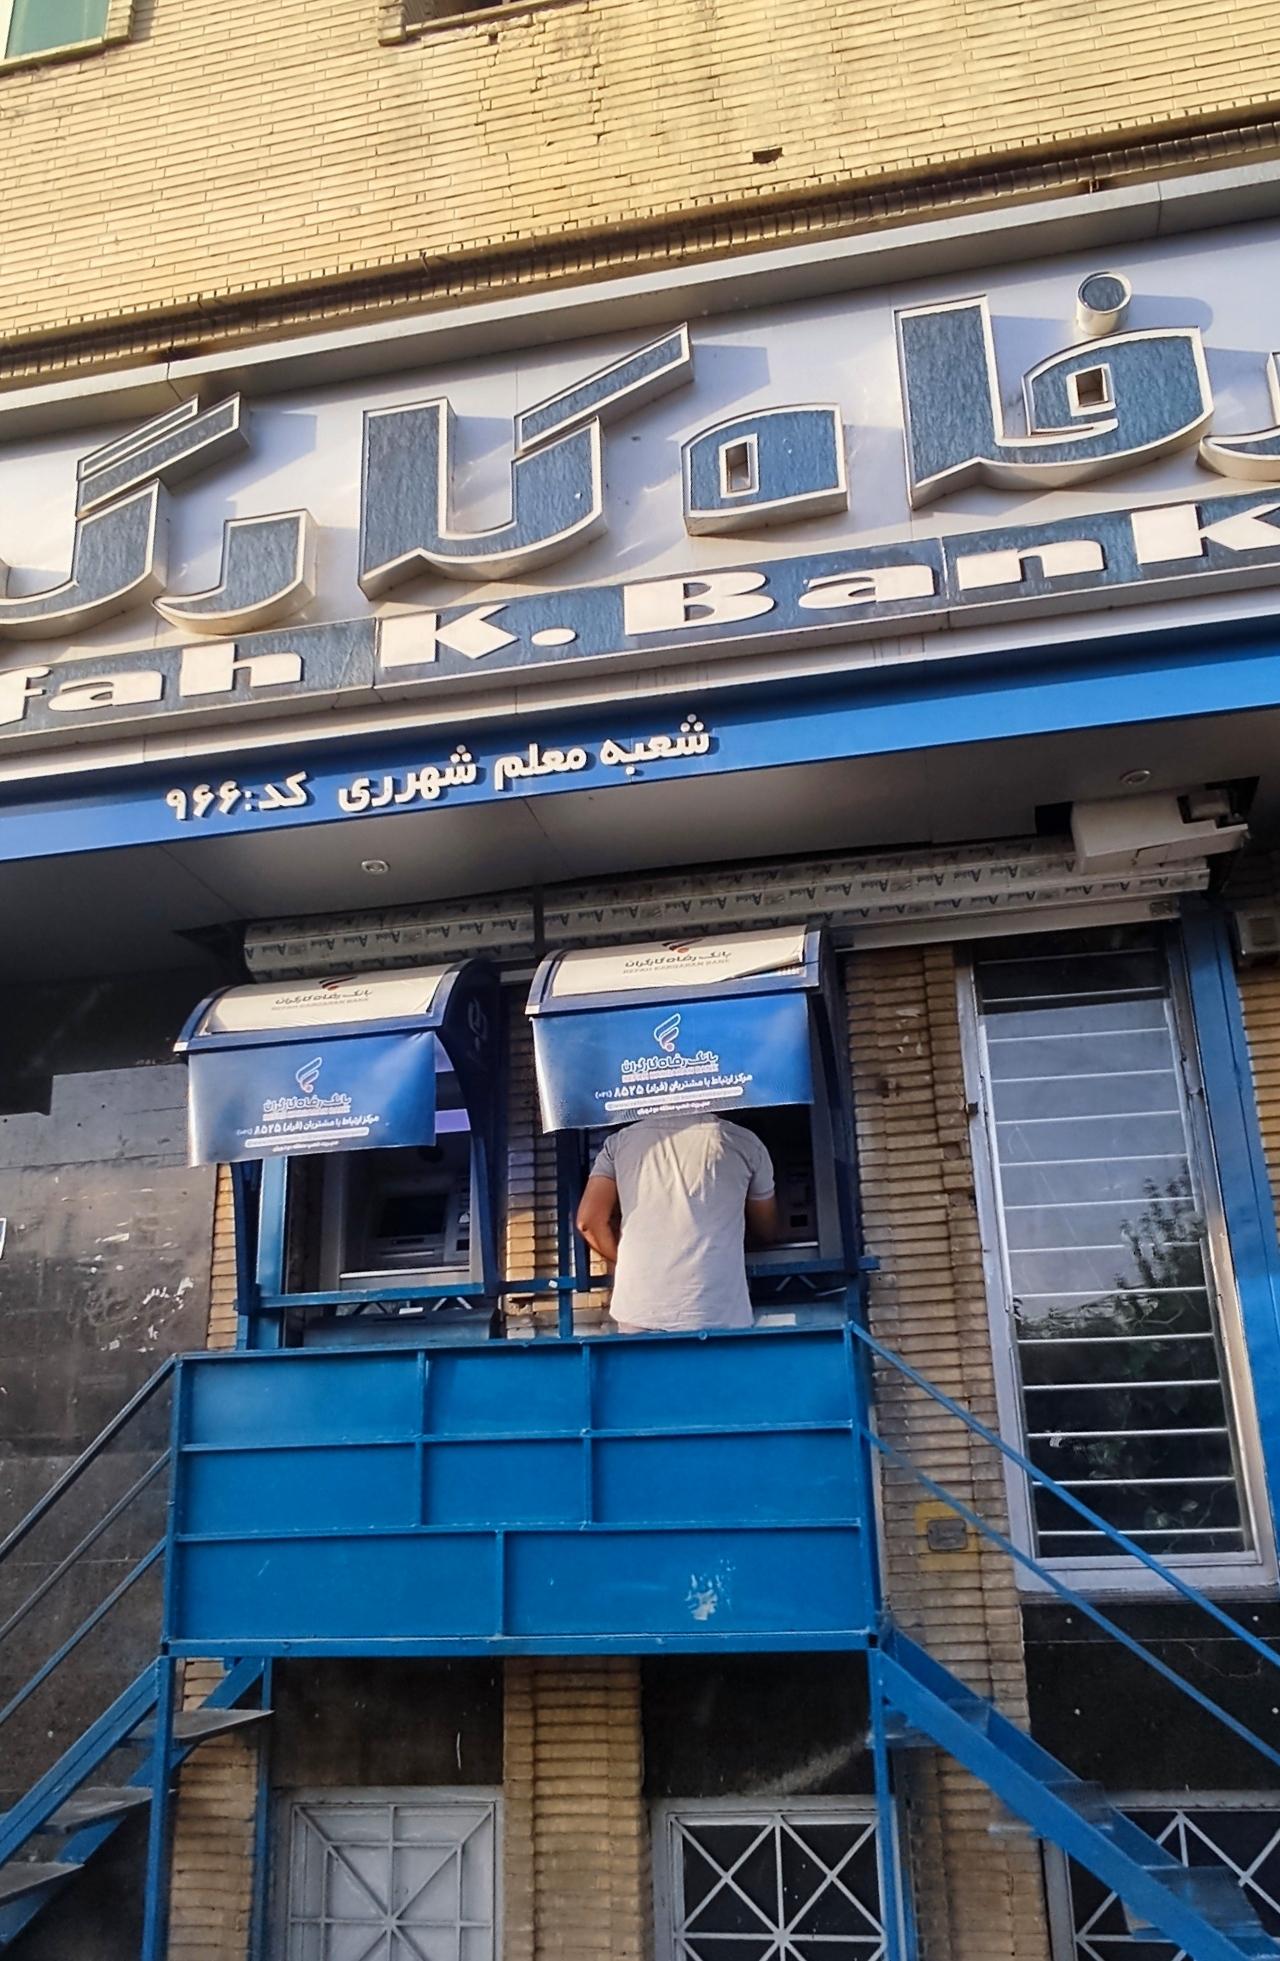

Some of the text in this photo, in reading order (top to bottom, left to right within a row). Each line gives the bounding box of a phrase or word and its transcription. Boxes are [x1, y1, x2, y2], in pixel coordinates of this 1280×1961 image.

[622, 502, 1280, 633] Bank
[493, 743, 587, 791] معلم
[600, 713, 711, 775] شعبه
[338, 744, 478, 813] شهرری
[621, 1050, 719, 1073] بانک رفاه کارگران
[262, 1092, 352, 1113] بانک رفاه کارگران
[613, 1086, 646, 1099] ۸۵۲۵
